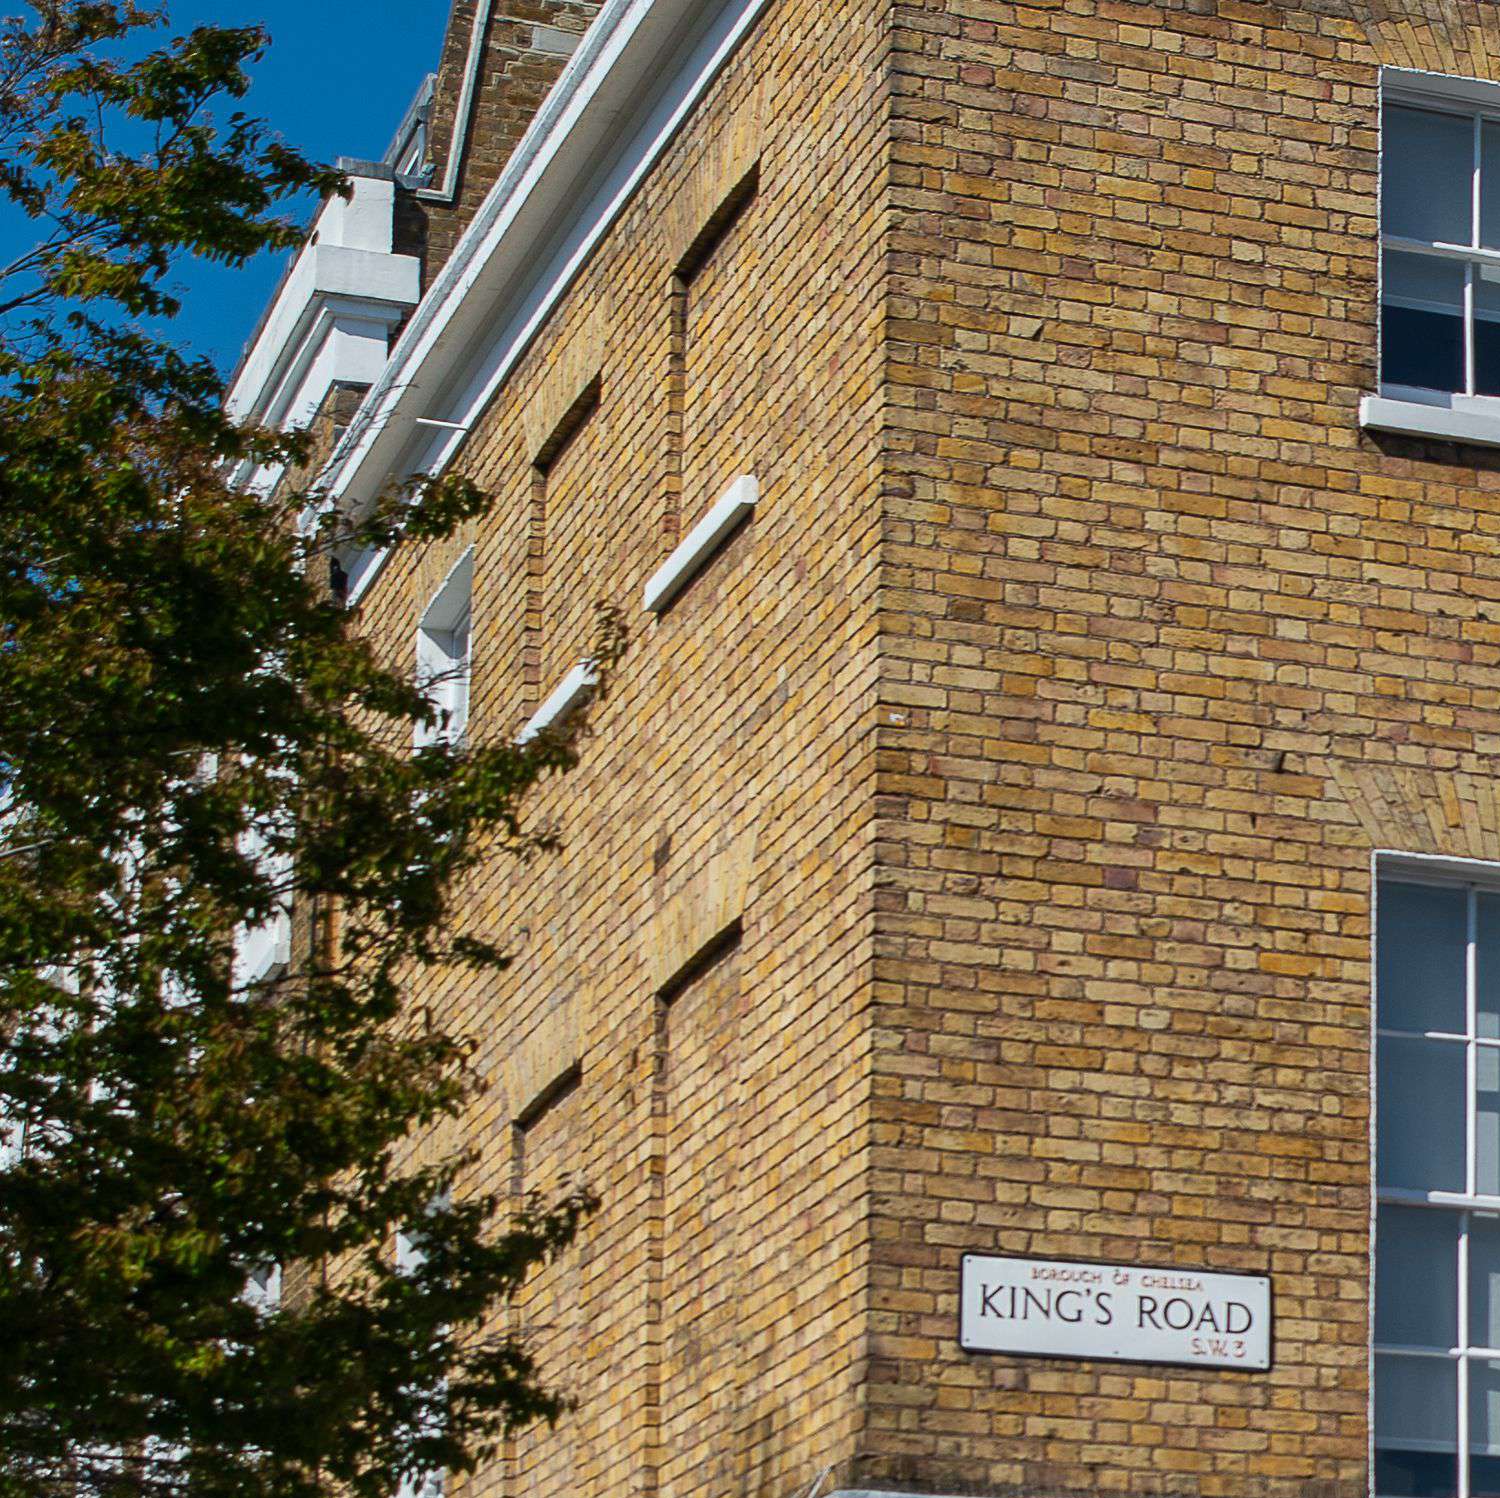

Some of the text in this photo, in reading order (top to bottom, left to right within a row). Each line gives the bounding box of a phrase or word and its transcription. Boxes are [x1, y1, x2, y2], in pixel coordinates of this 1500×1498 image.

[1031, 1267, 1102, 1284] BOROUGH
[1141, 1275, 1204, 1292] CHELSEA
[980, 1284, 1253, 1335] KING'S ROAD
